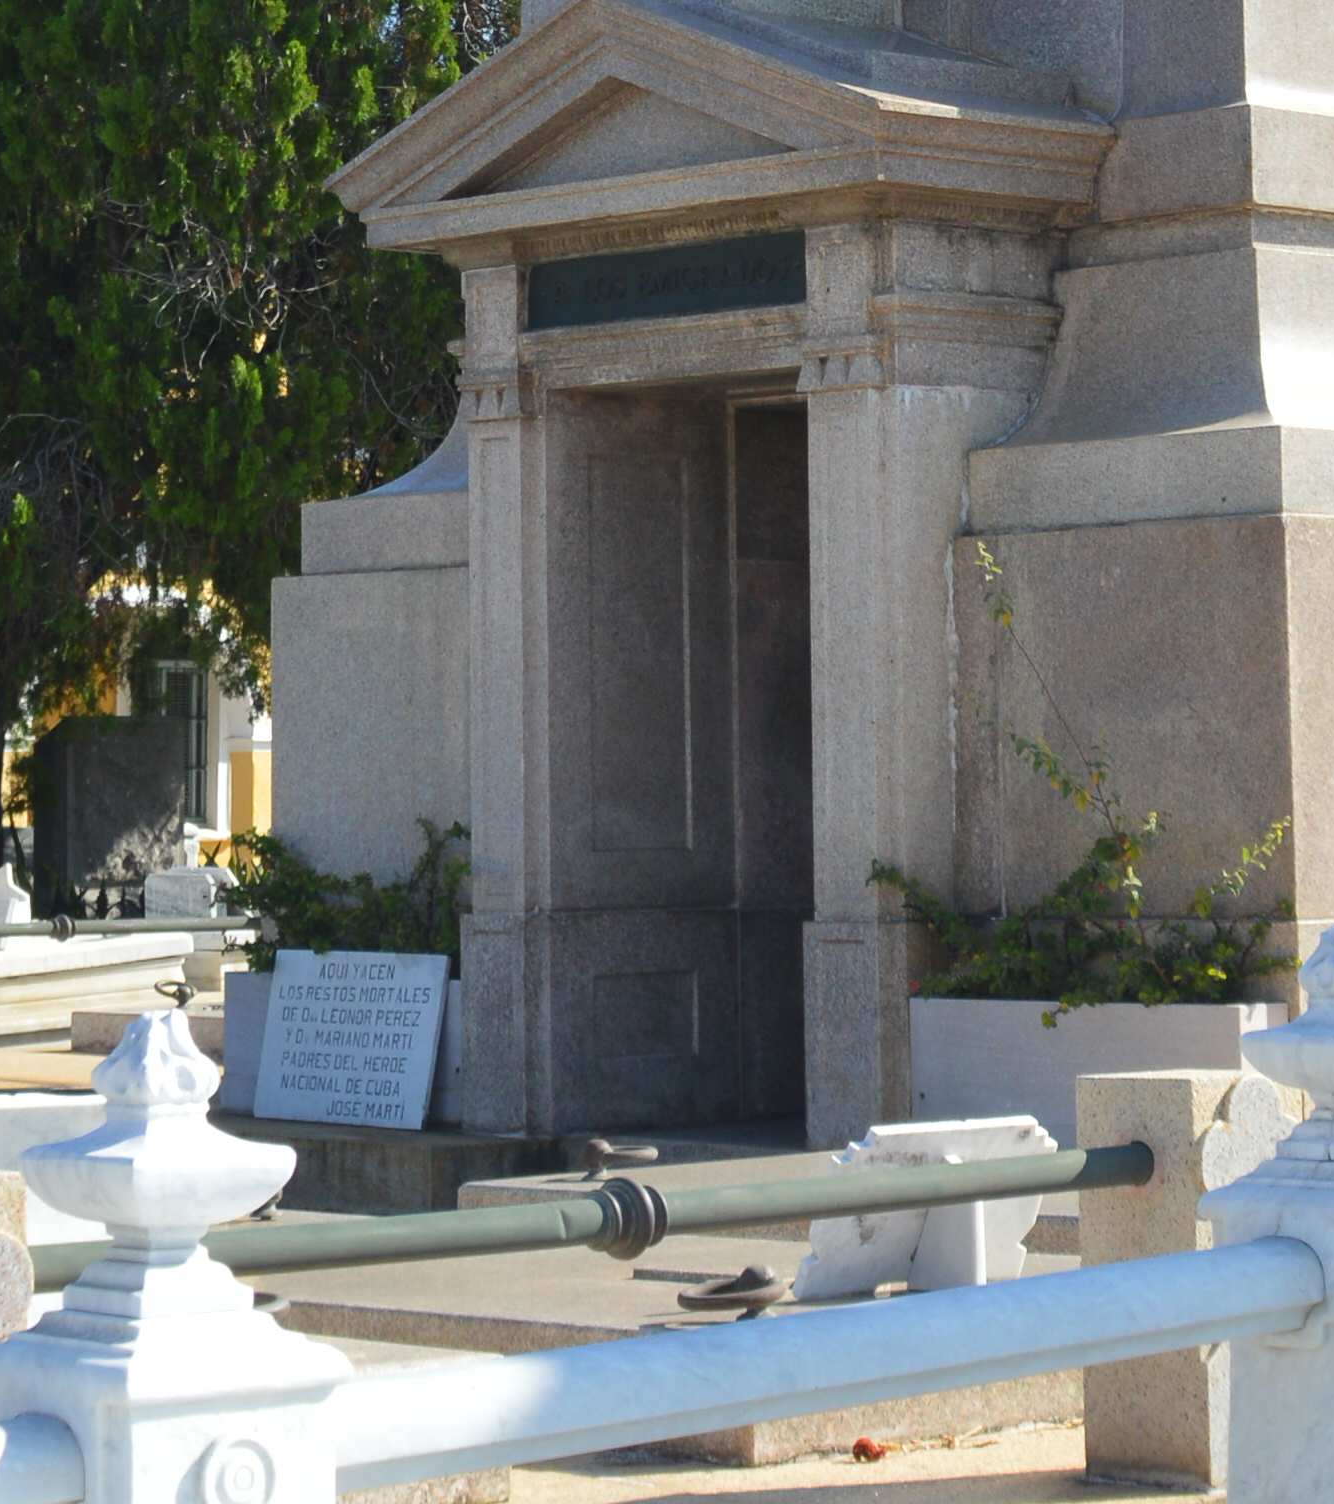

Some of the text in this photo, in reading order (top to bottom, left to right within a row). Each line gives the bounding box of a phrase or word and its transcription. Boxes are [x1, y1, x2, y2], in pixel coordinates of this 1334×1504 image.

[319, 962, 396, 982] AQUI YACEN
[279, 985, 431, 1004] LOS RESTOS MORTALES
[282, 1006, 298, 1021] DE
[321, 1008, 372, 1026] LEONOR
[375, 1010, 421, 1027] PEREZ
[286, 1028, 293, 1042] Y
[316, 1029, 369, 1049] MARIANO
[281, 1051, 407, 1074] PADRES DEL HEROE
[280, 1074, 400, 1097] NACIONAL DE CUBA
[326, 1098, 405, 1121] JOSÉ MARTÍ
